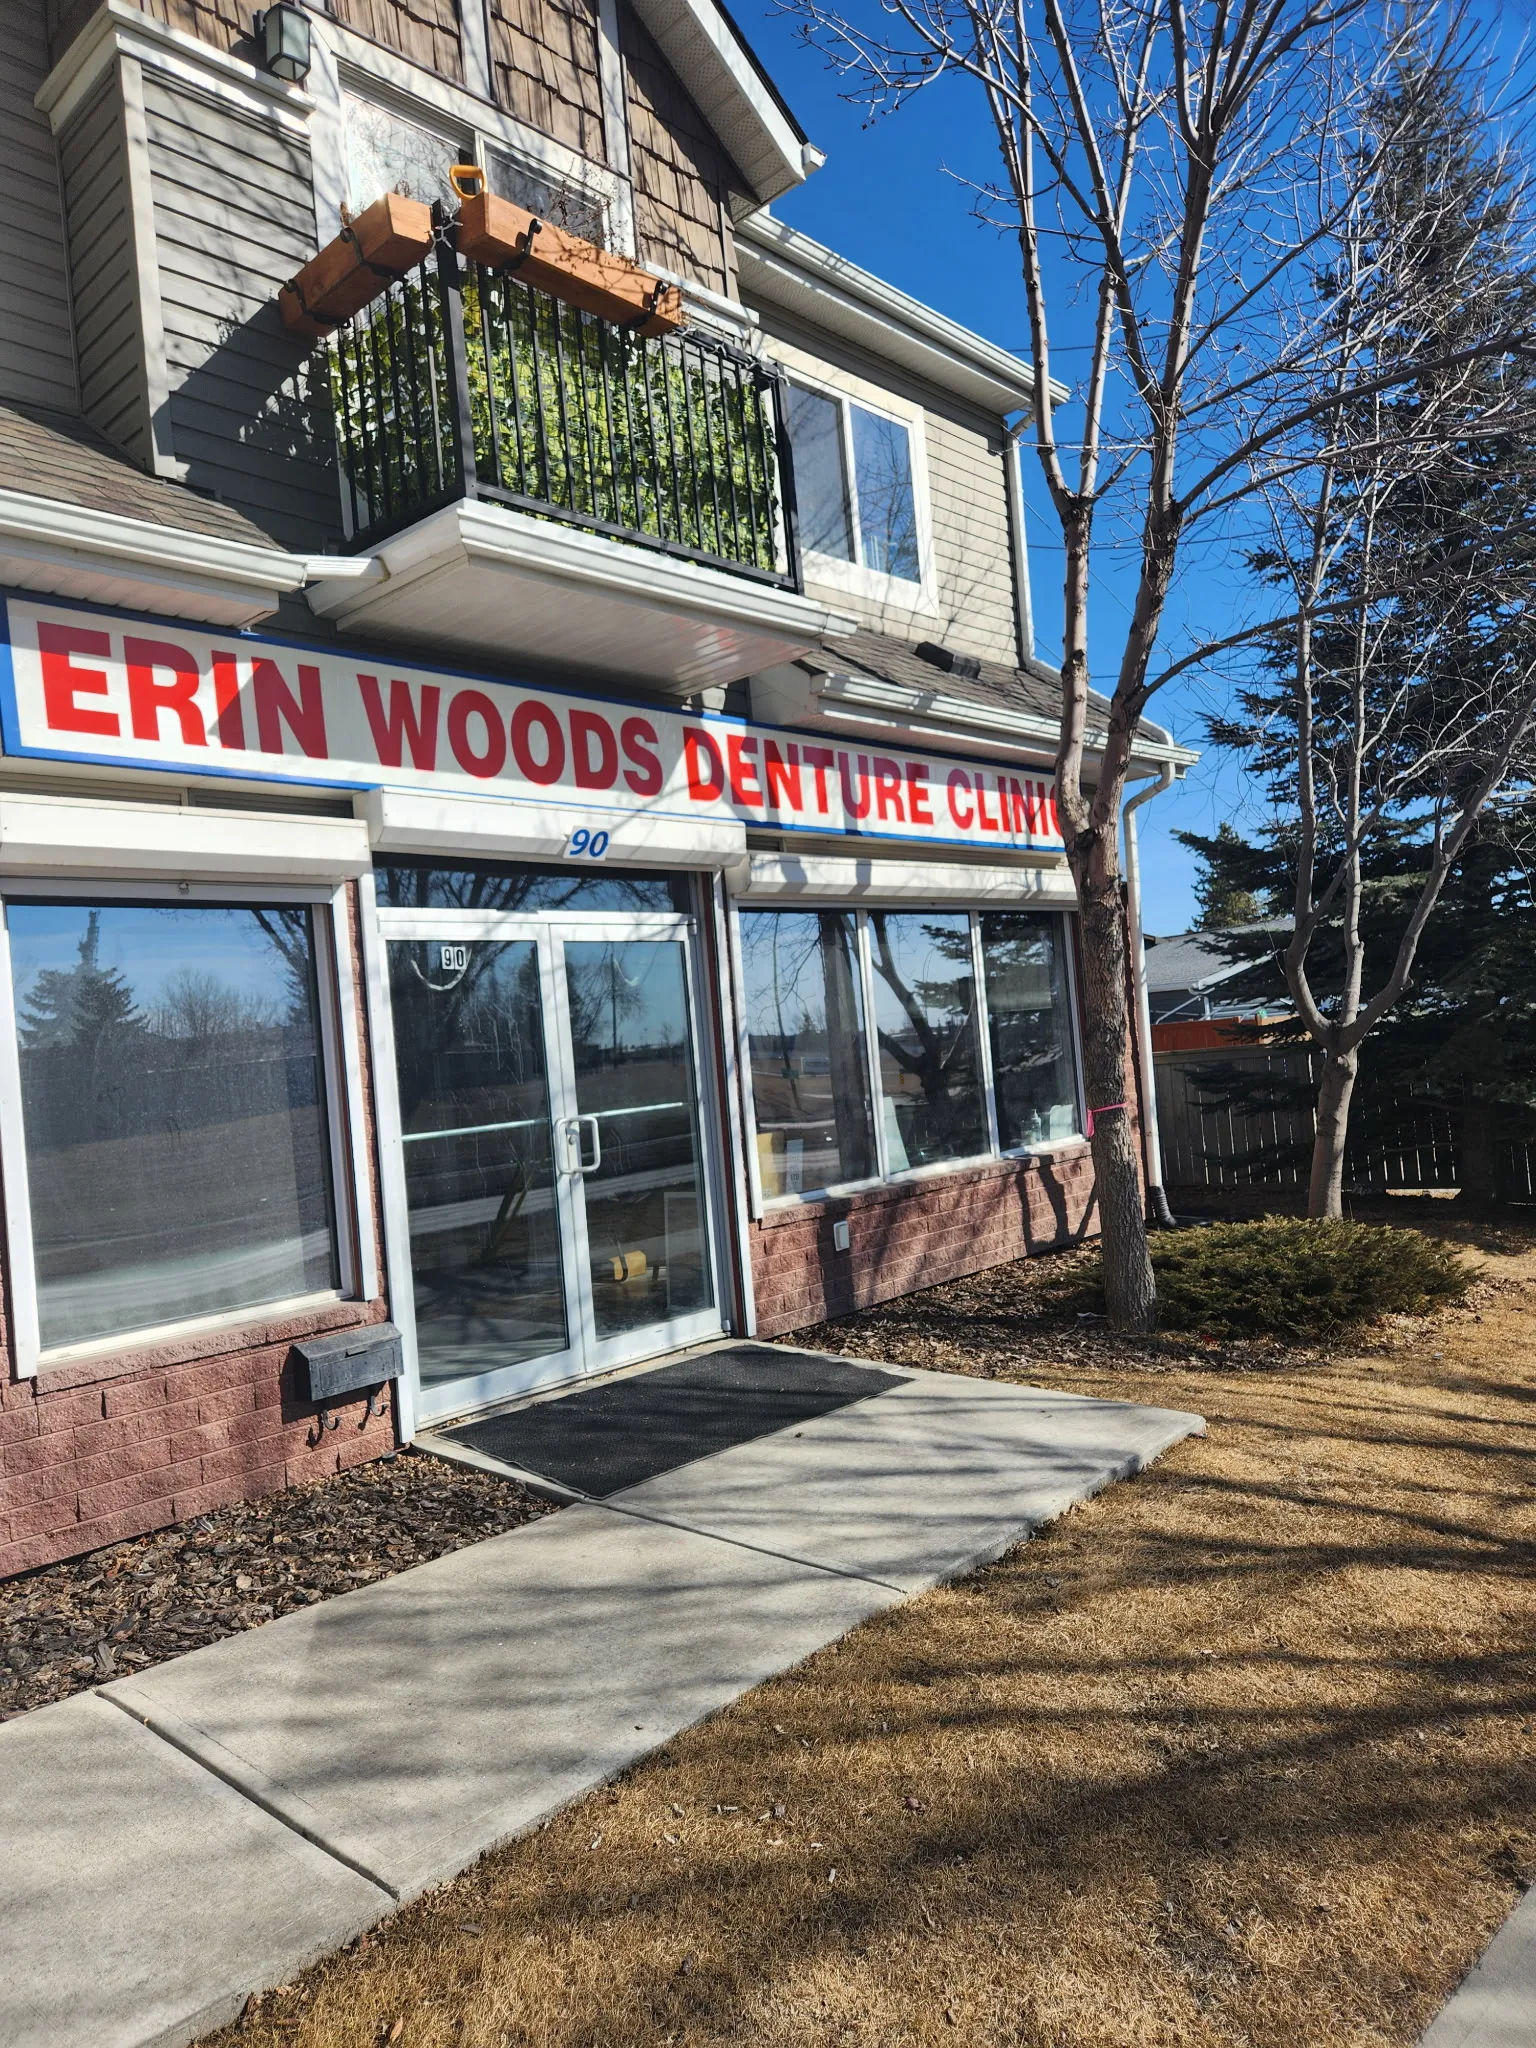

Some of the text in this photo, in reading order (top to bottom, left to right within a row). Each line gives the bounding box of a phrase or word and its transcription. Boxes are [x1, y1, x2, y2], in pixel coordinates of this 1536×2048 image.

[37, 621, 328, 759] ERIN
[356, 673, 663, 798] WOODS
[682, 726, 934, 825] DENTURE
[569, 828, 609, 857] 90
[444, 948, 464, 967] 90
